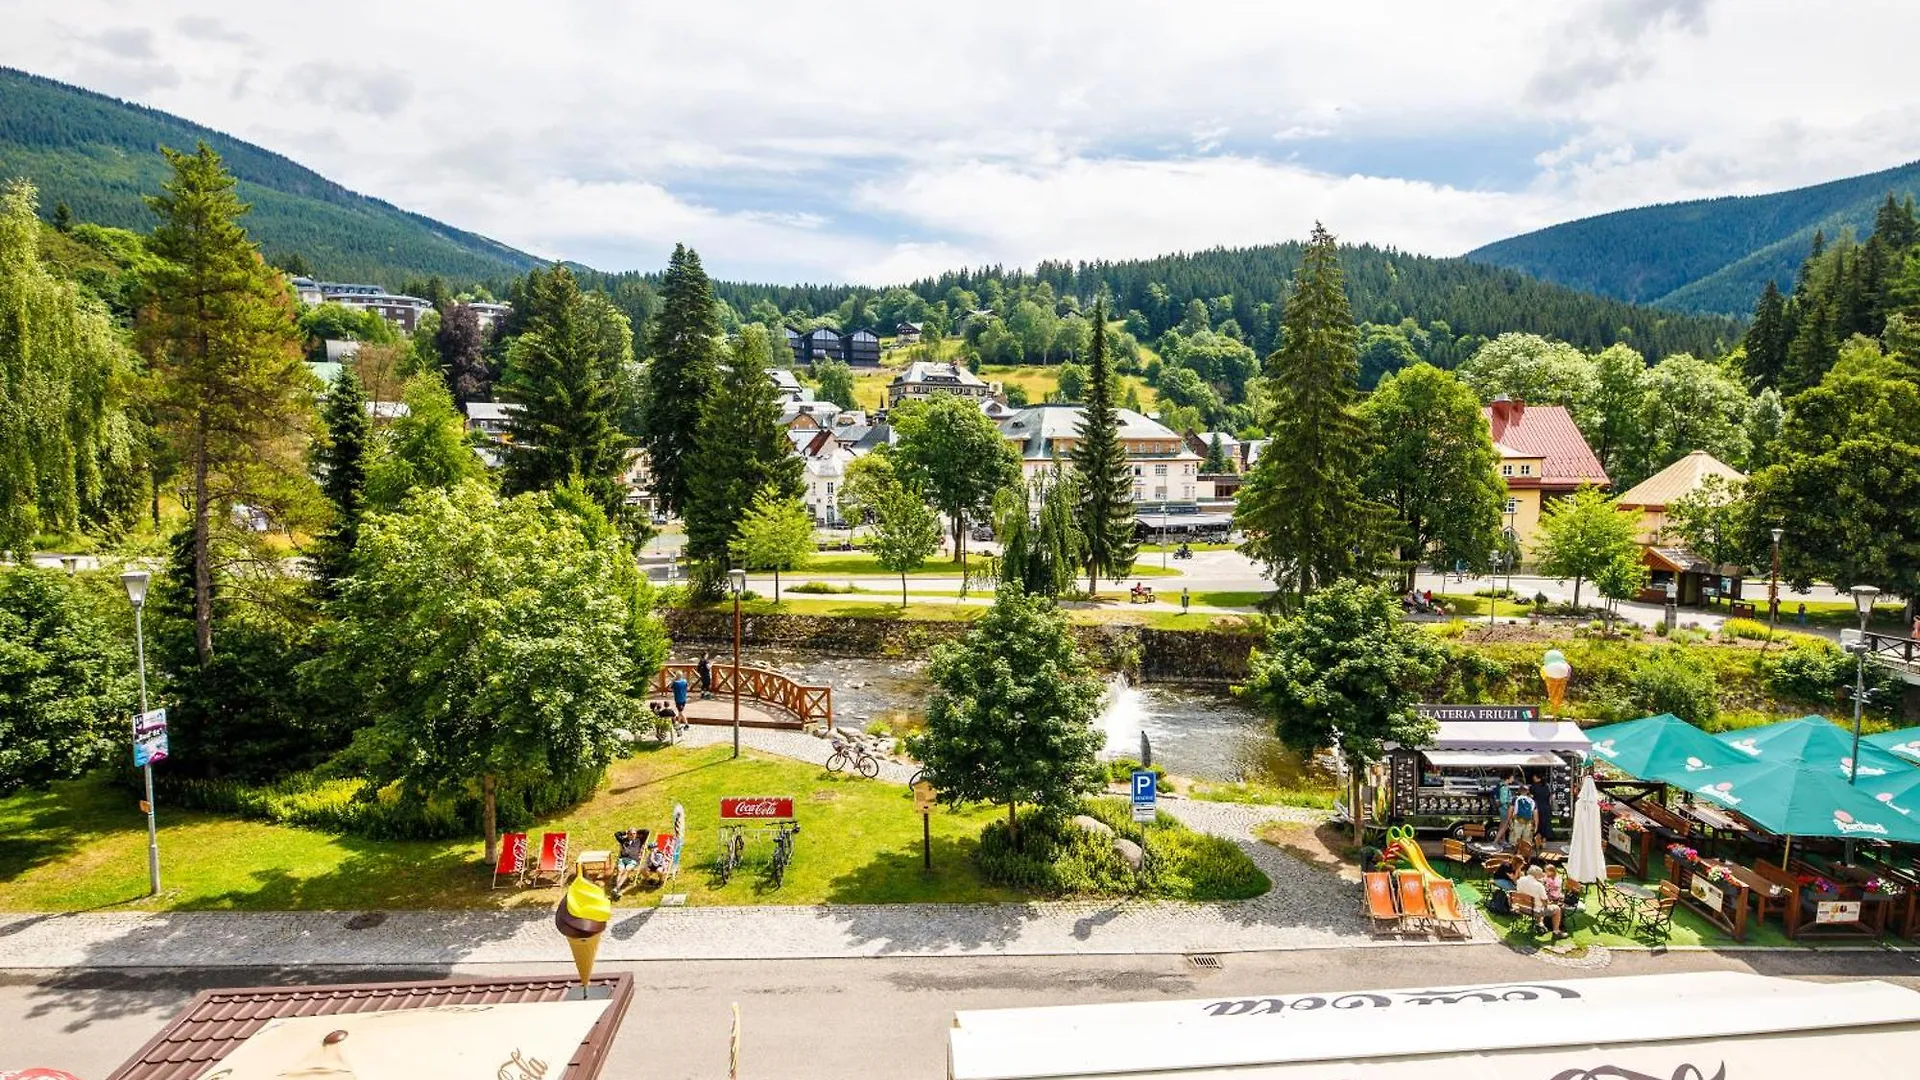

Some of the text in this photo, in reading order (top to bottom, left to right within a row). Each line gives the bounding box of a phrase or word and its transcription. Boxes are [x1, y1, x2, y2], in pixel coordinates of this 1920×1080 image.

[1419, 709, 1518, 719] ELATERIA FRIULI
[1137, 776, 1151, 795] P
[734, 801, 778, 816] Coca-Cola
